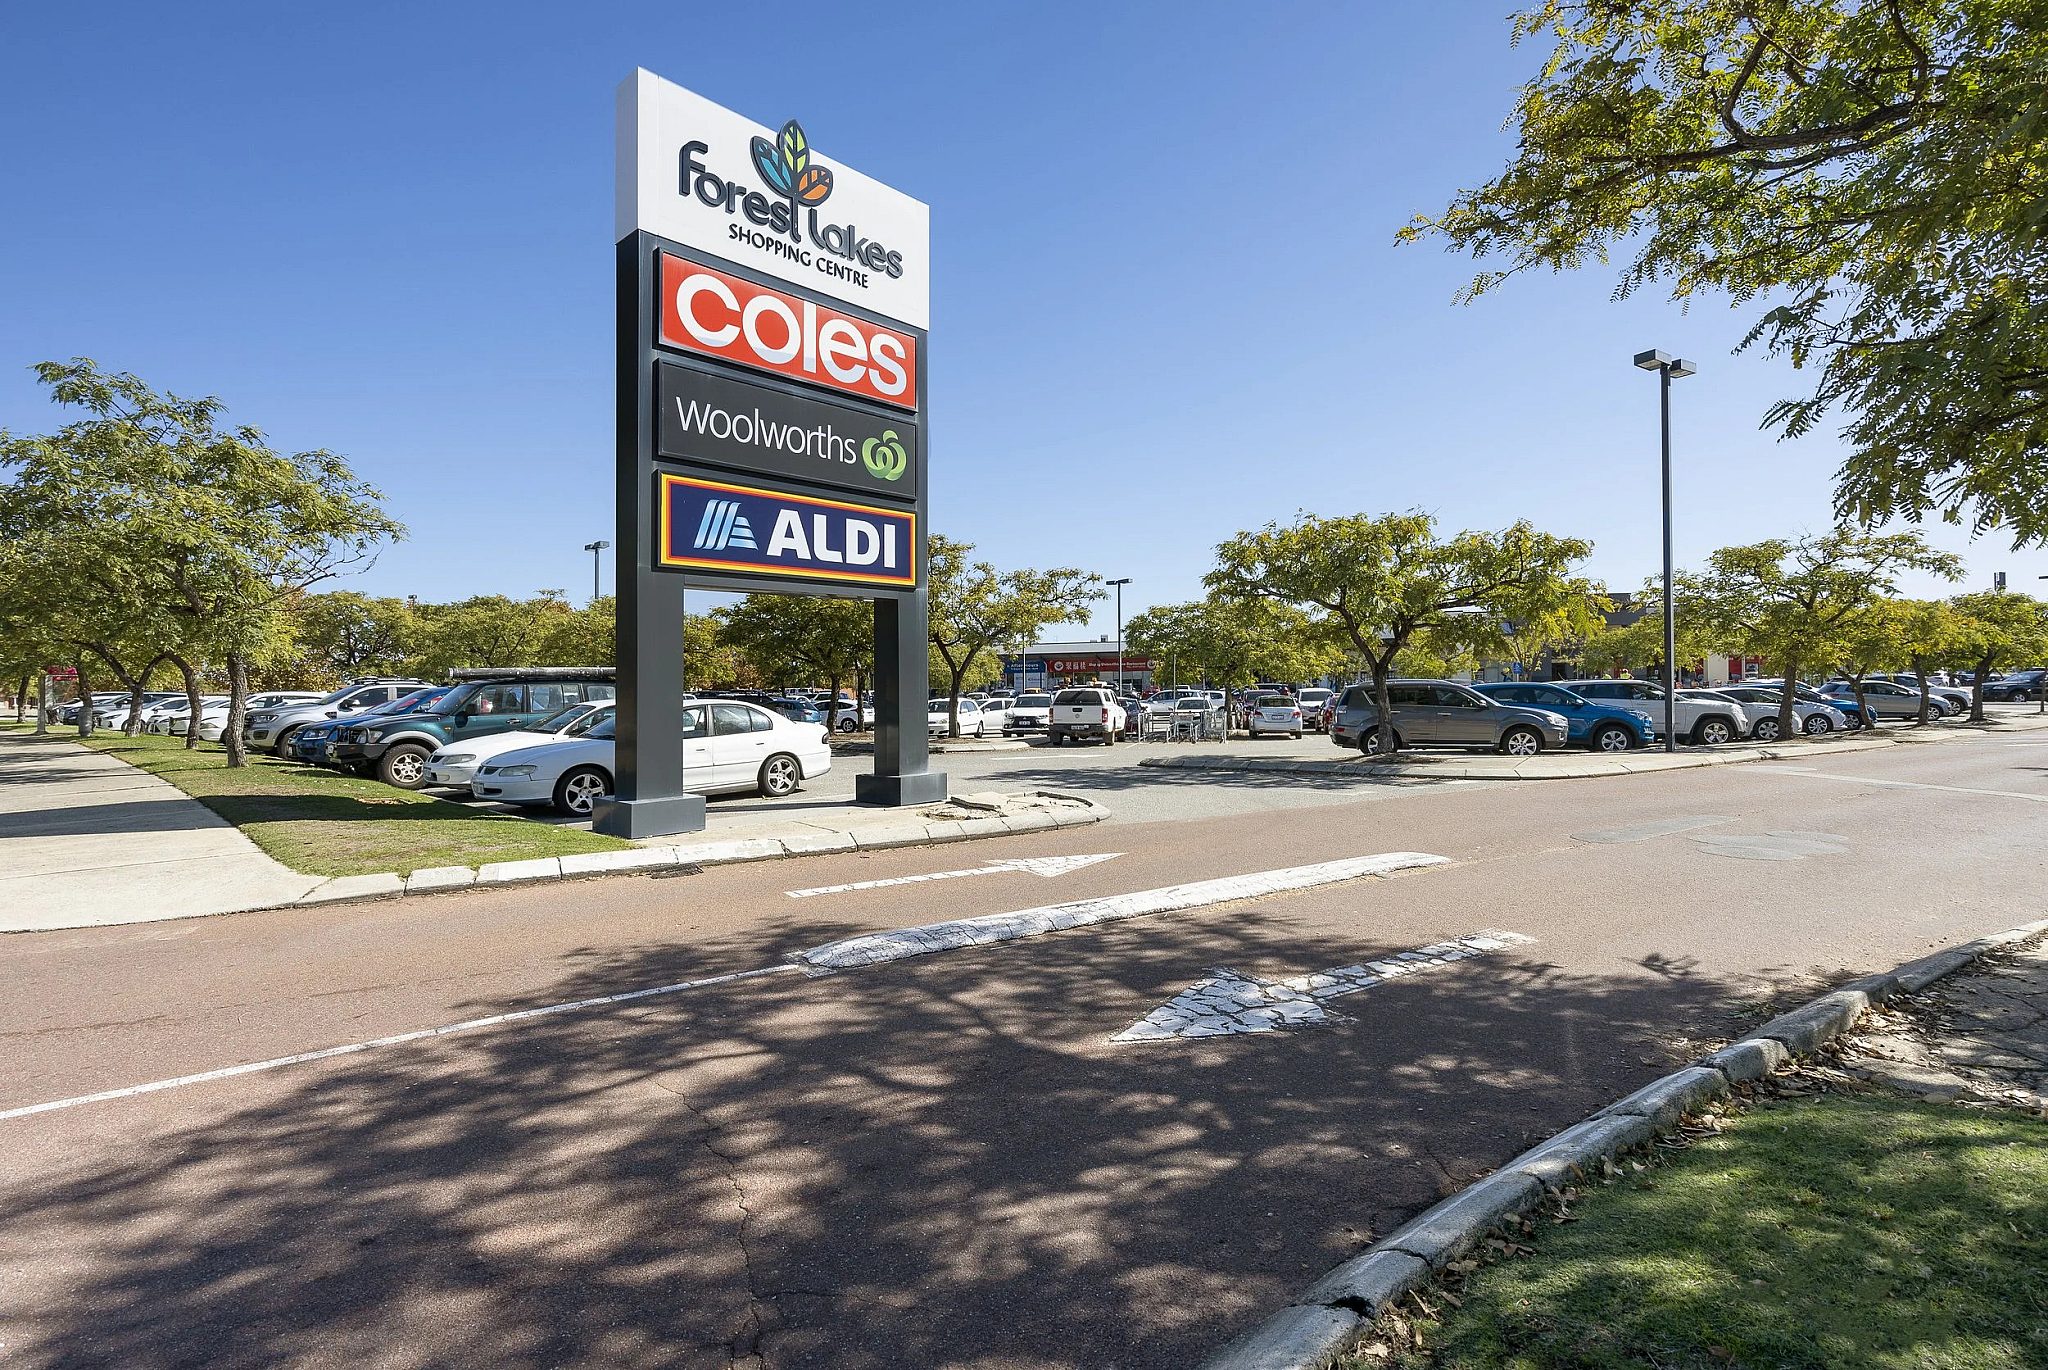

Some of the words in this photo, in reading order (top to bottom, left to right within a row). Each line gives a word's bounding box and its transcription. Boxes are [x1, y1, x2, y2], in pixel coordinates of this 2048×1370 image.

[728, 223, 812, 267] SHOPPING
[816, 256, 869, 289] CENTRE
[676, 273, 907, 397] coles
[675, 396, 857, 465] Woolworths
[766, 508, 896, 569] ALDI
